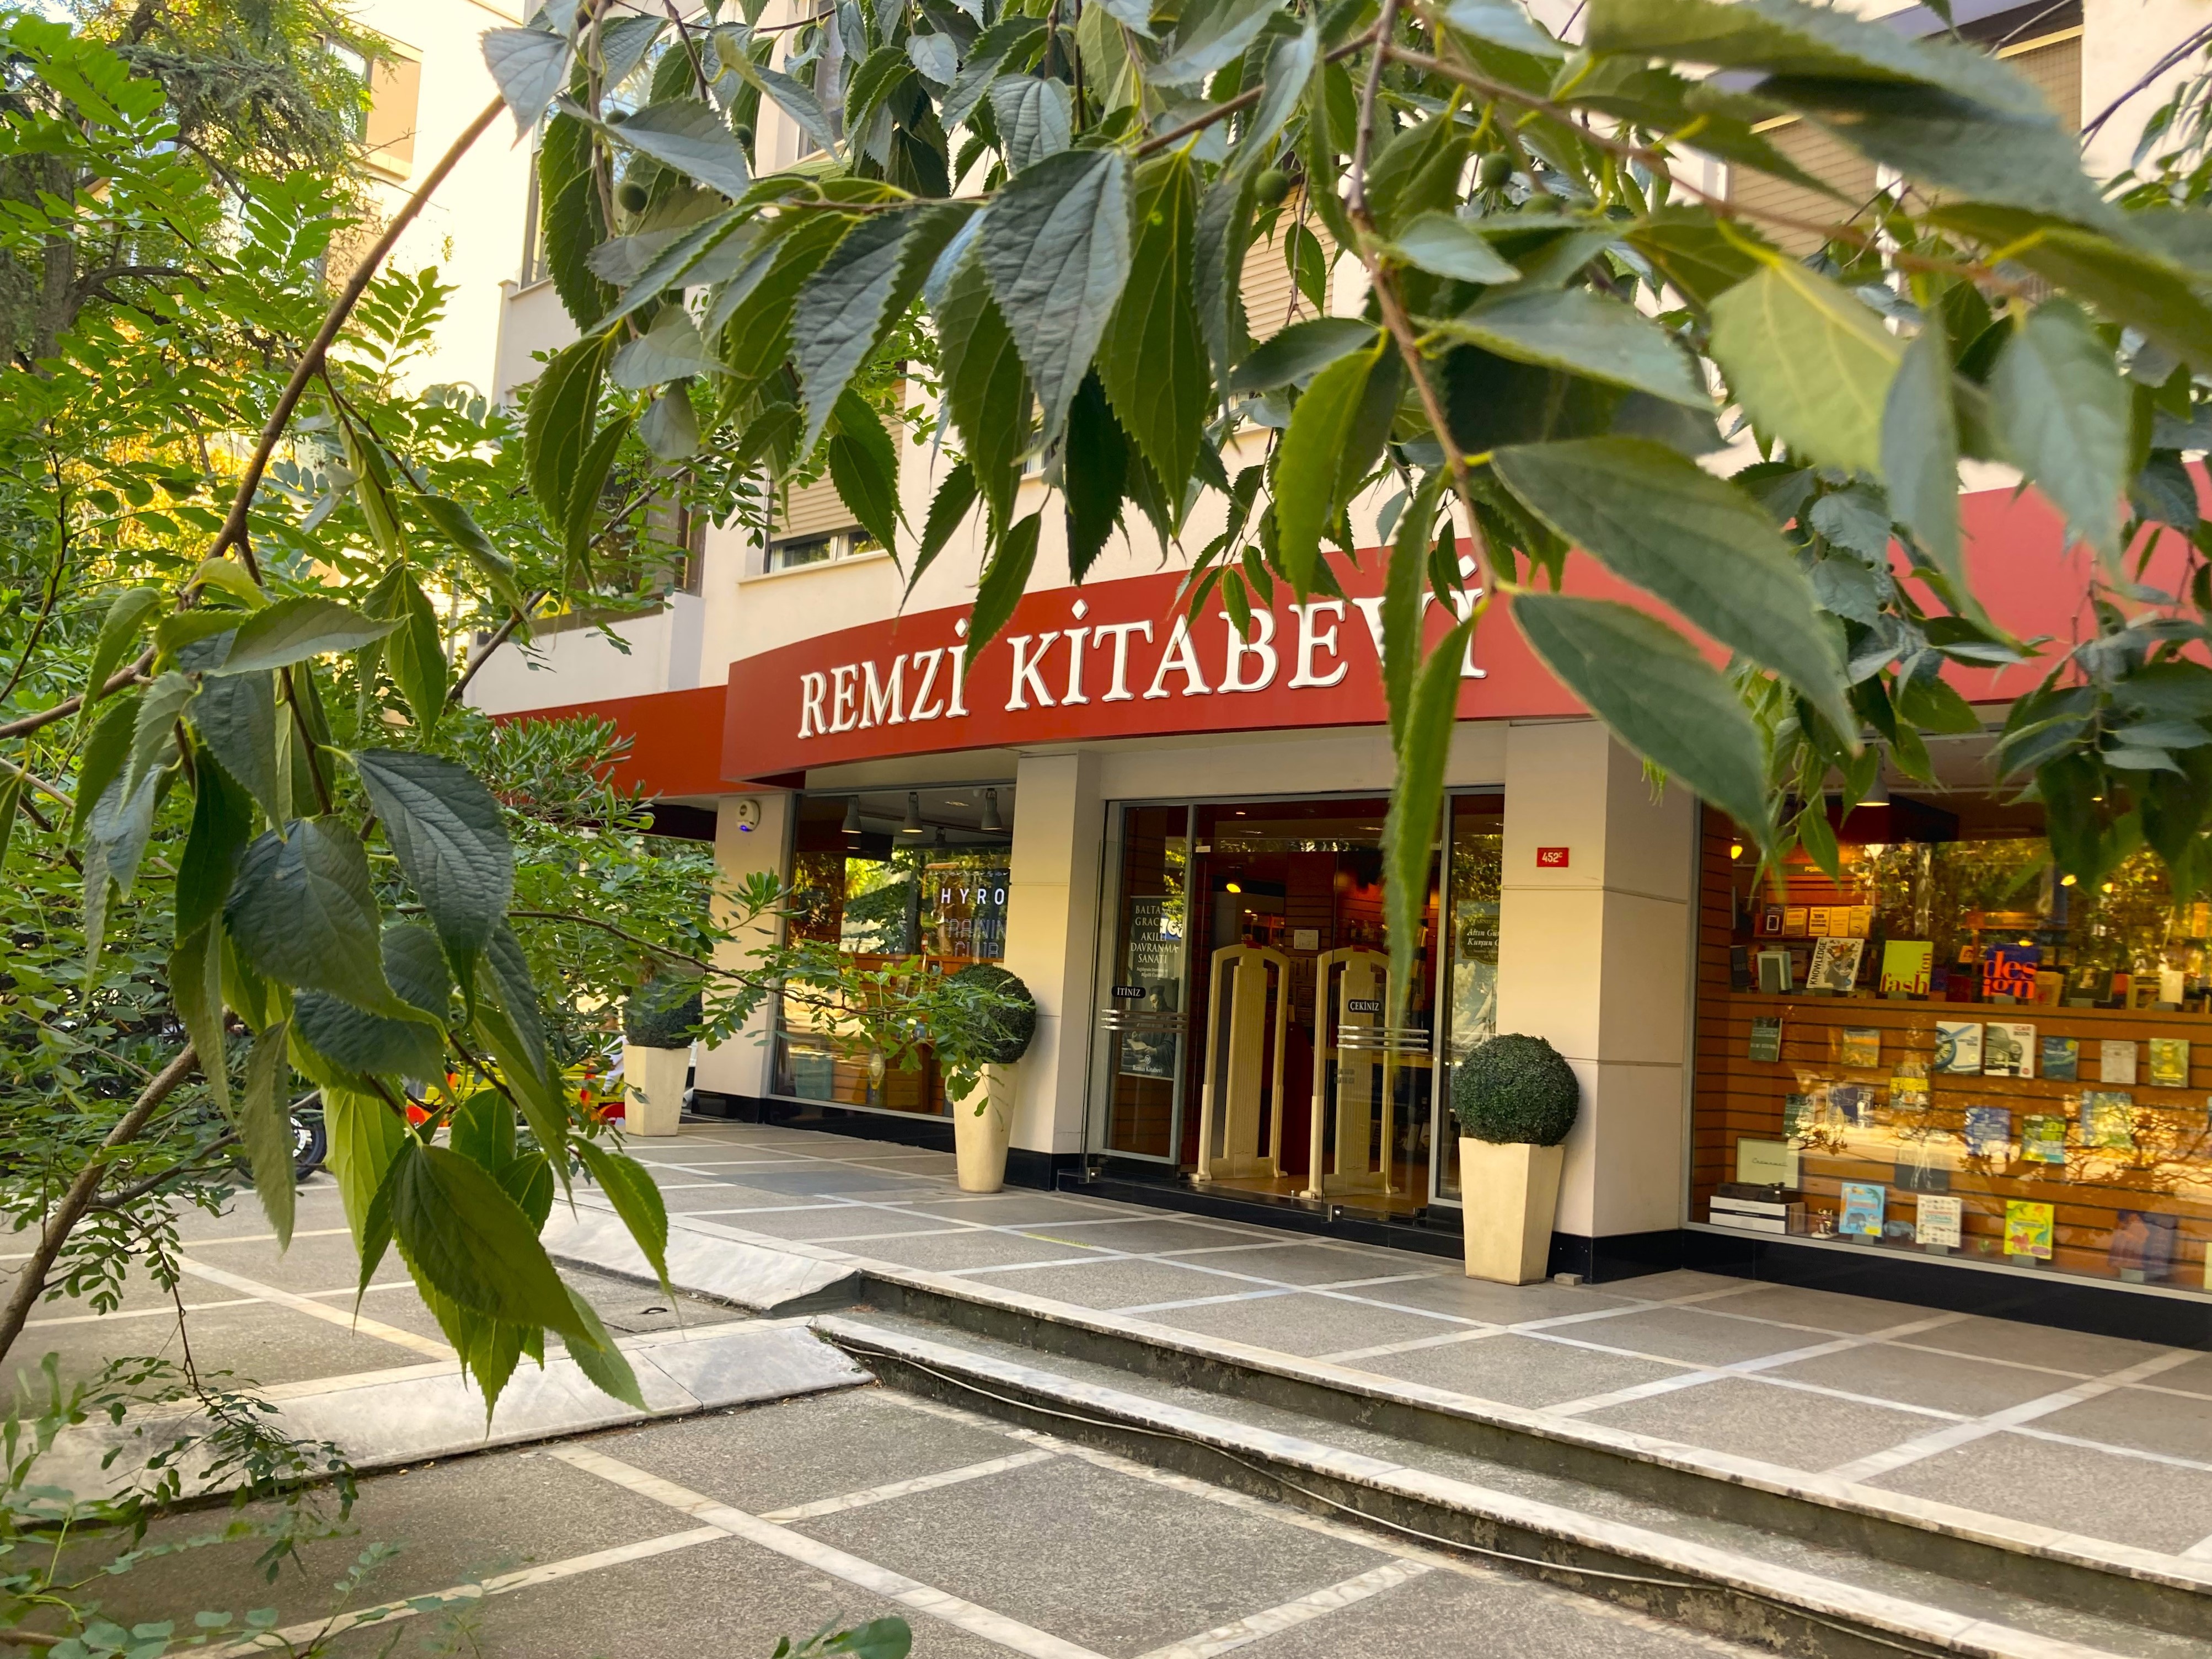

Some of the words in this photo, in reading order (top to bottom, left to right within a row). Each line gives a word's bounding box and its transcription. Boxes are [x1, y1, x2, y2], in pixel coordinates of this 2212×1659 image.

[797, 618, 970, 740] REMZİ
[1809, 941, 1827, 985] KNOWLEDGE
[1117, 987, 1141, 997] İTİNİZ
[1349, 1000, 1379, 1012] ÇEKİNİZ
